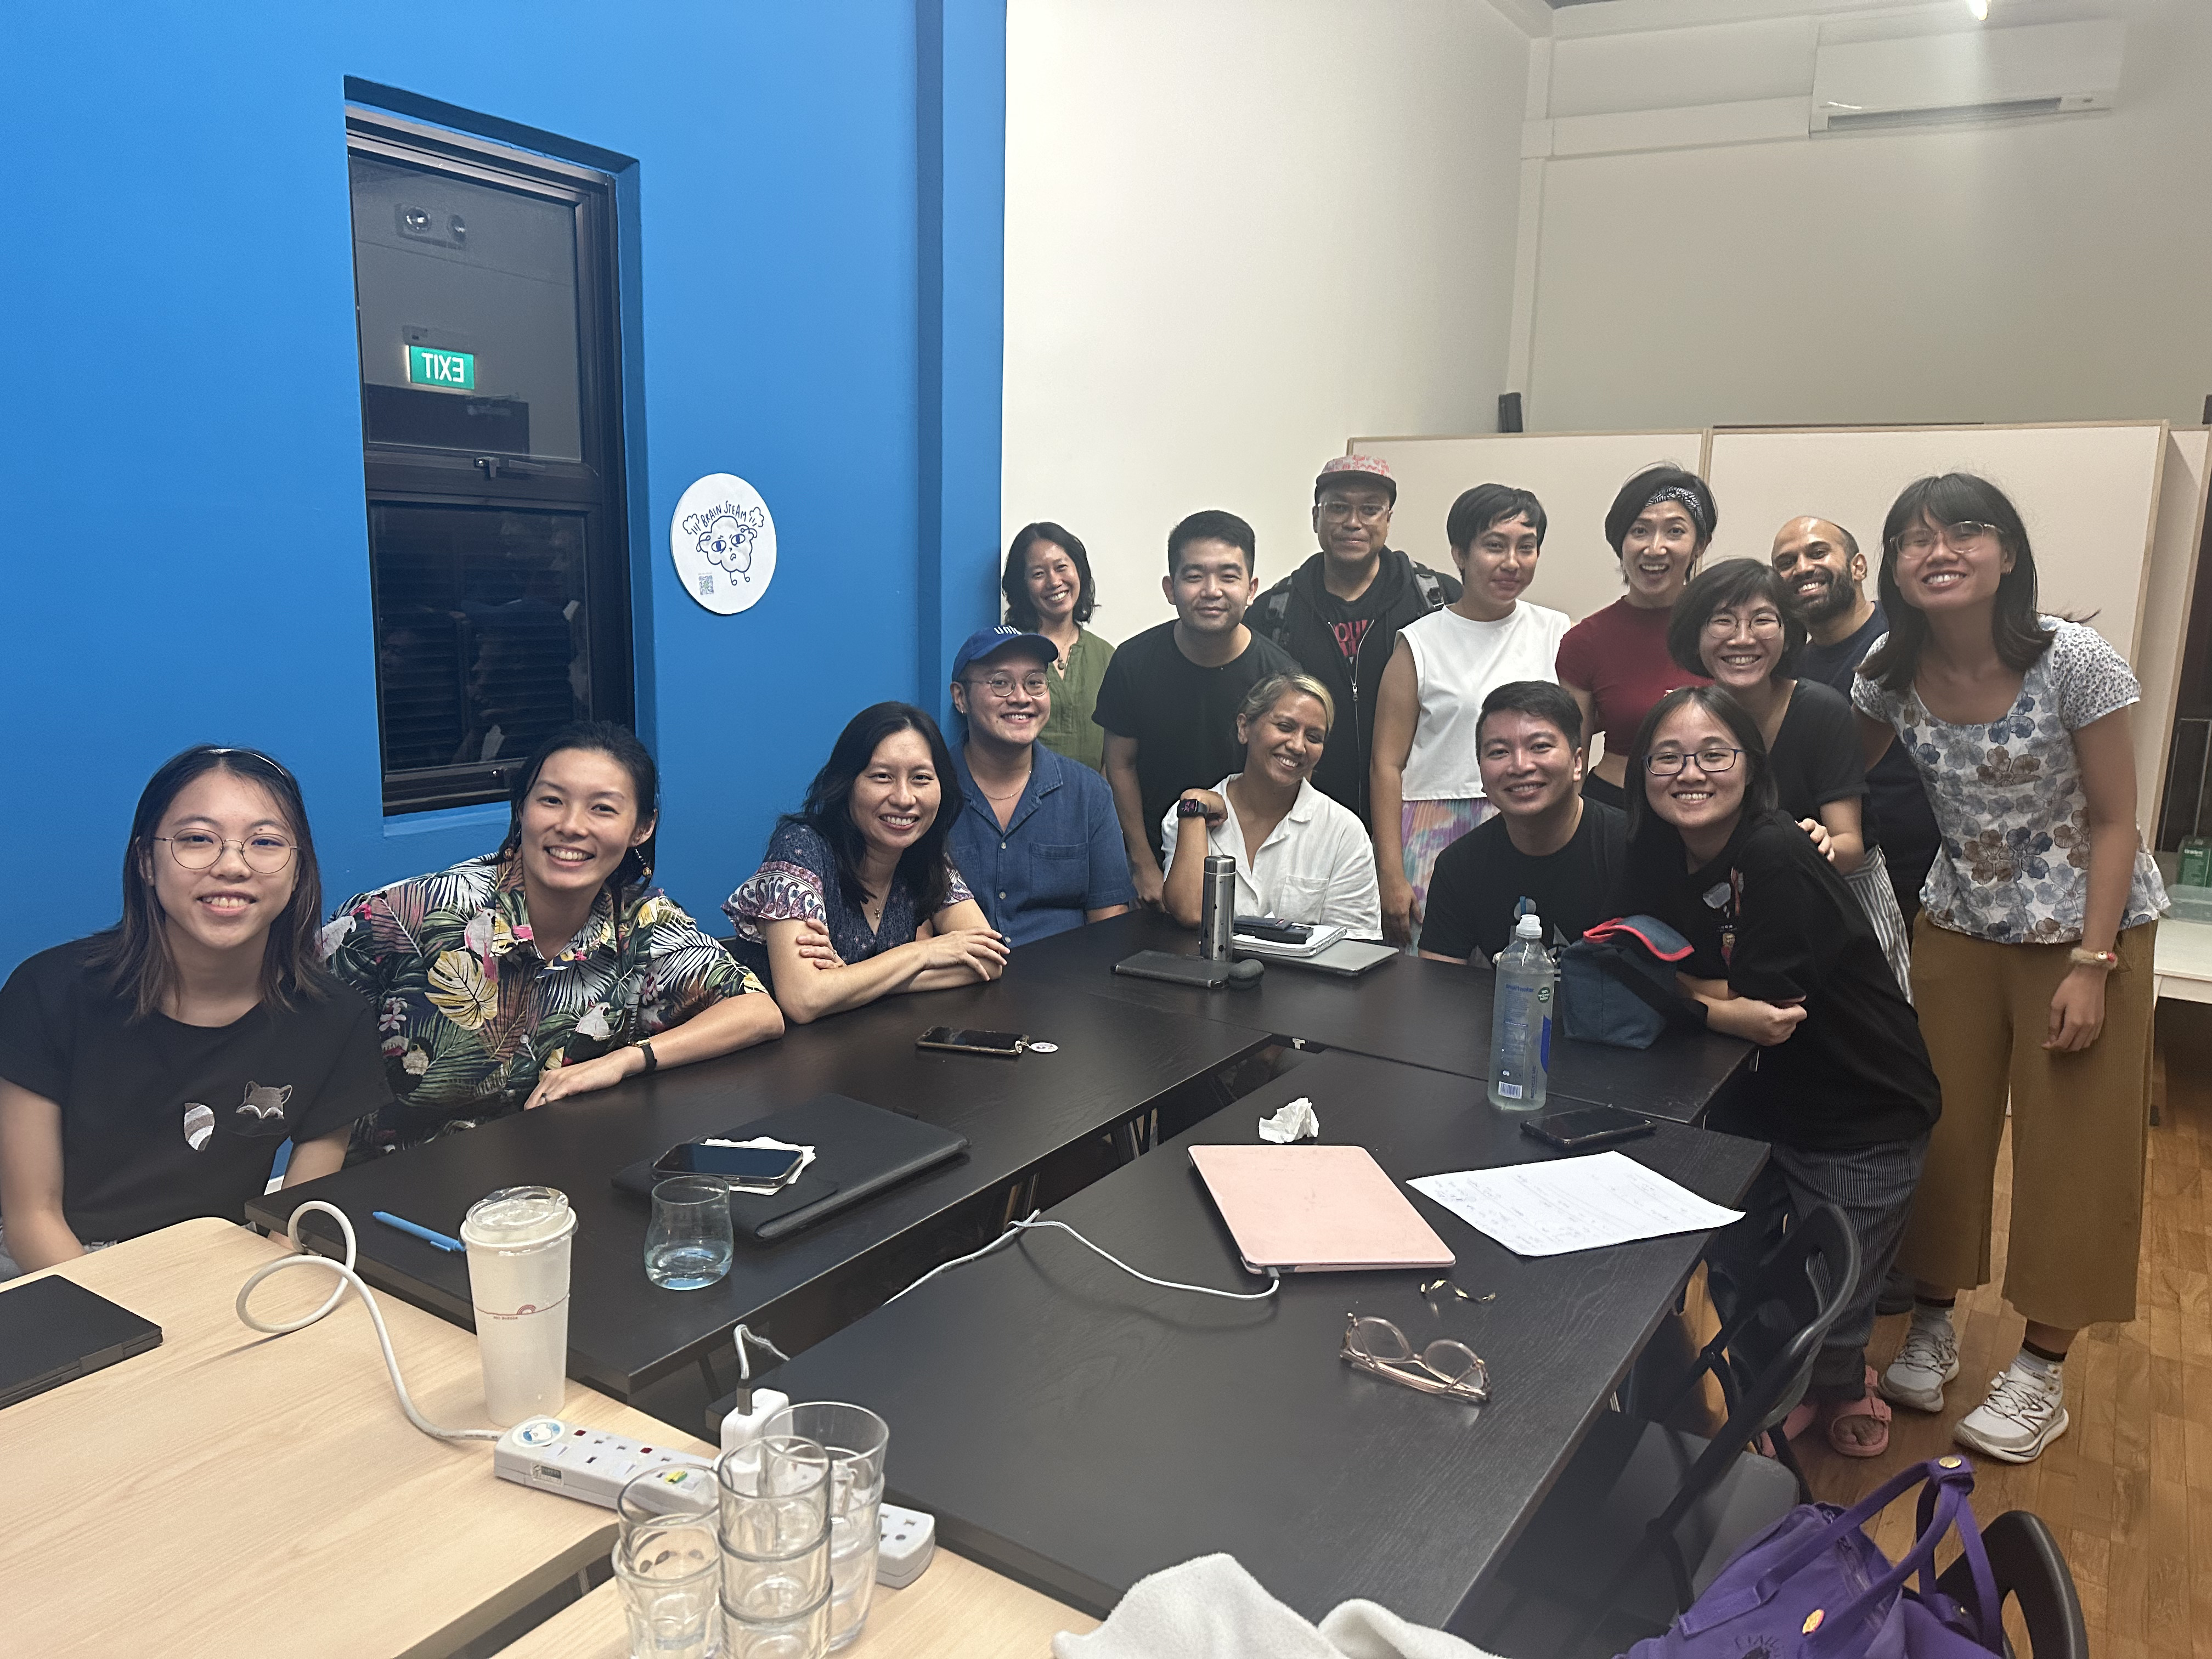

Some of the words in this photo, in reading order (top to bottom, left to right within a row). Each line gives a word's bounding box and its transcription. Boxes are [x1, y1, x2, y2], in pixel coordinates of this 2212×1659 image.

[700, 504, 721, 527] BRAIN
[724, 500, 747, 522] STEAM
[1333, 619, 1368, 642] OU
